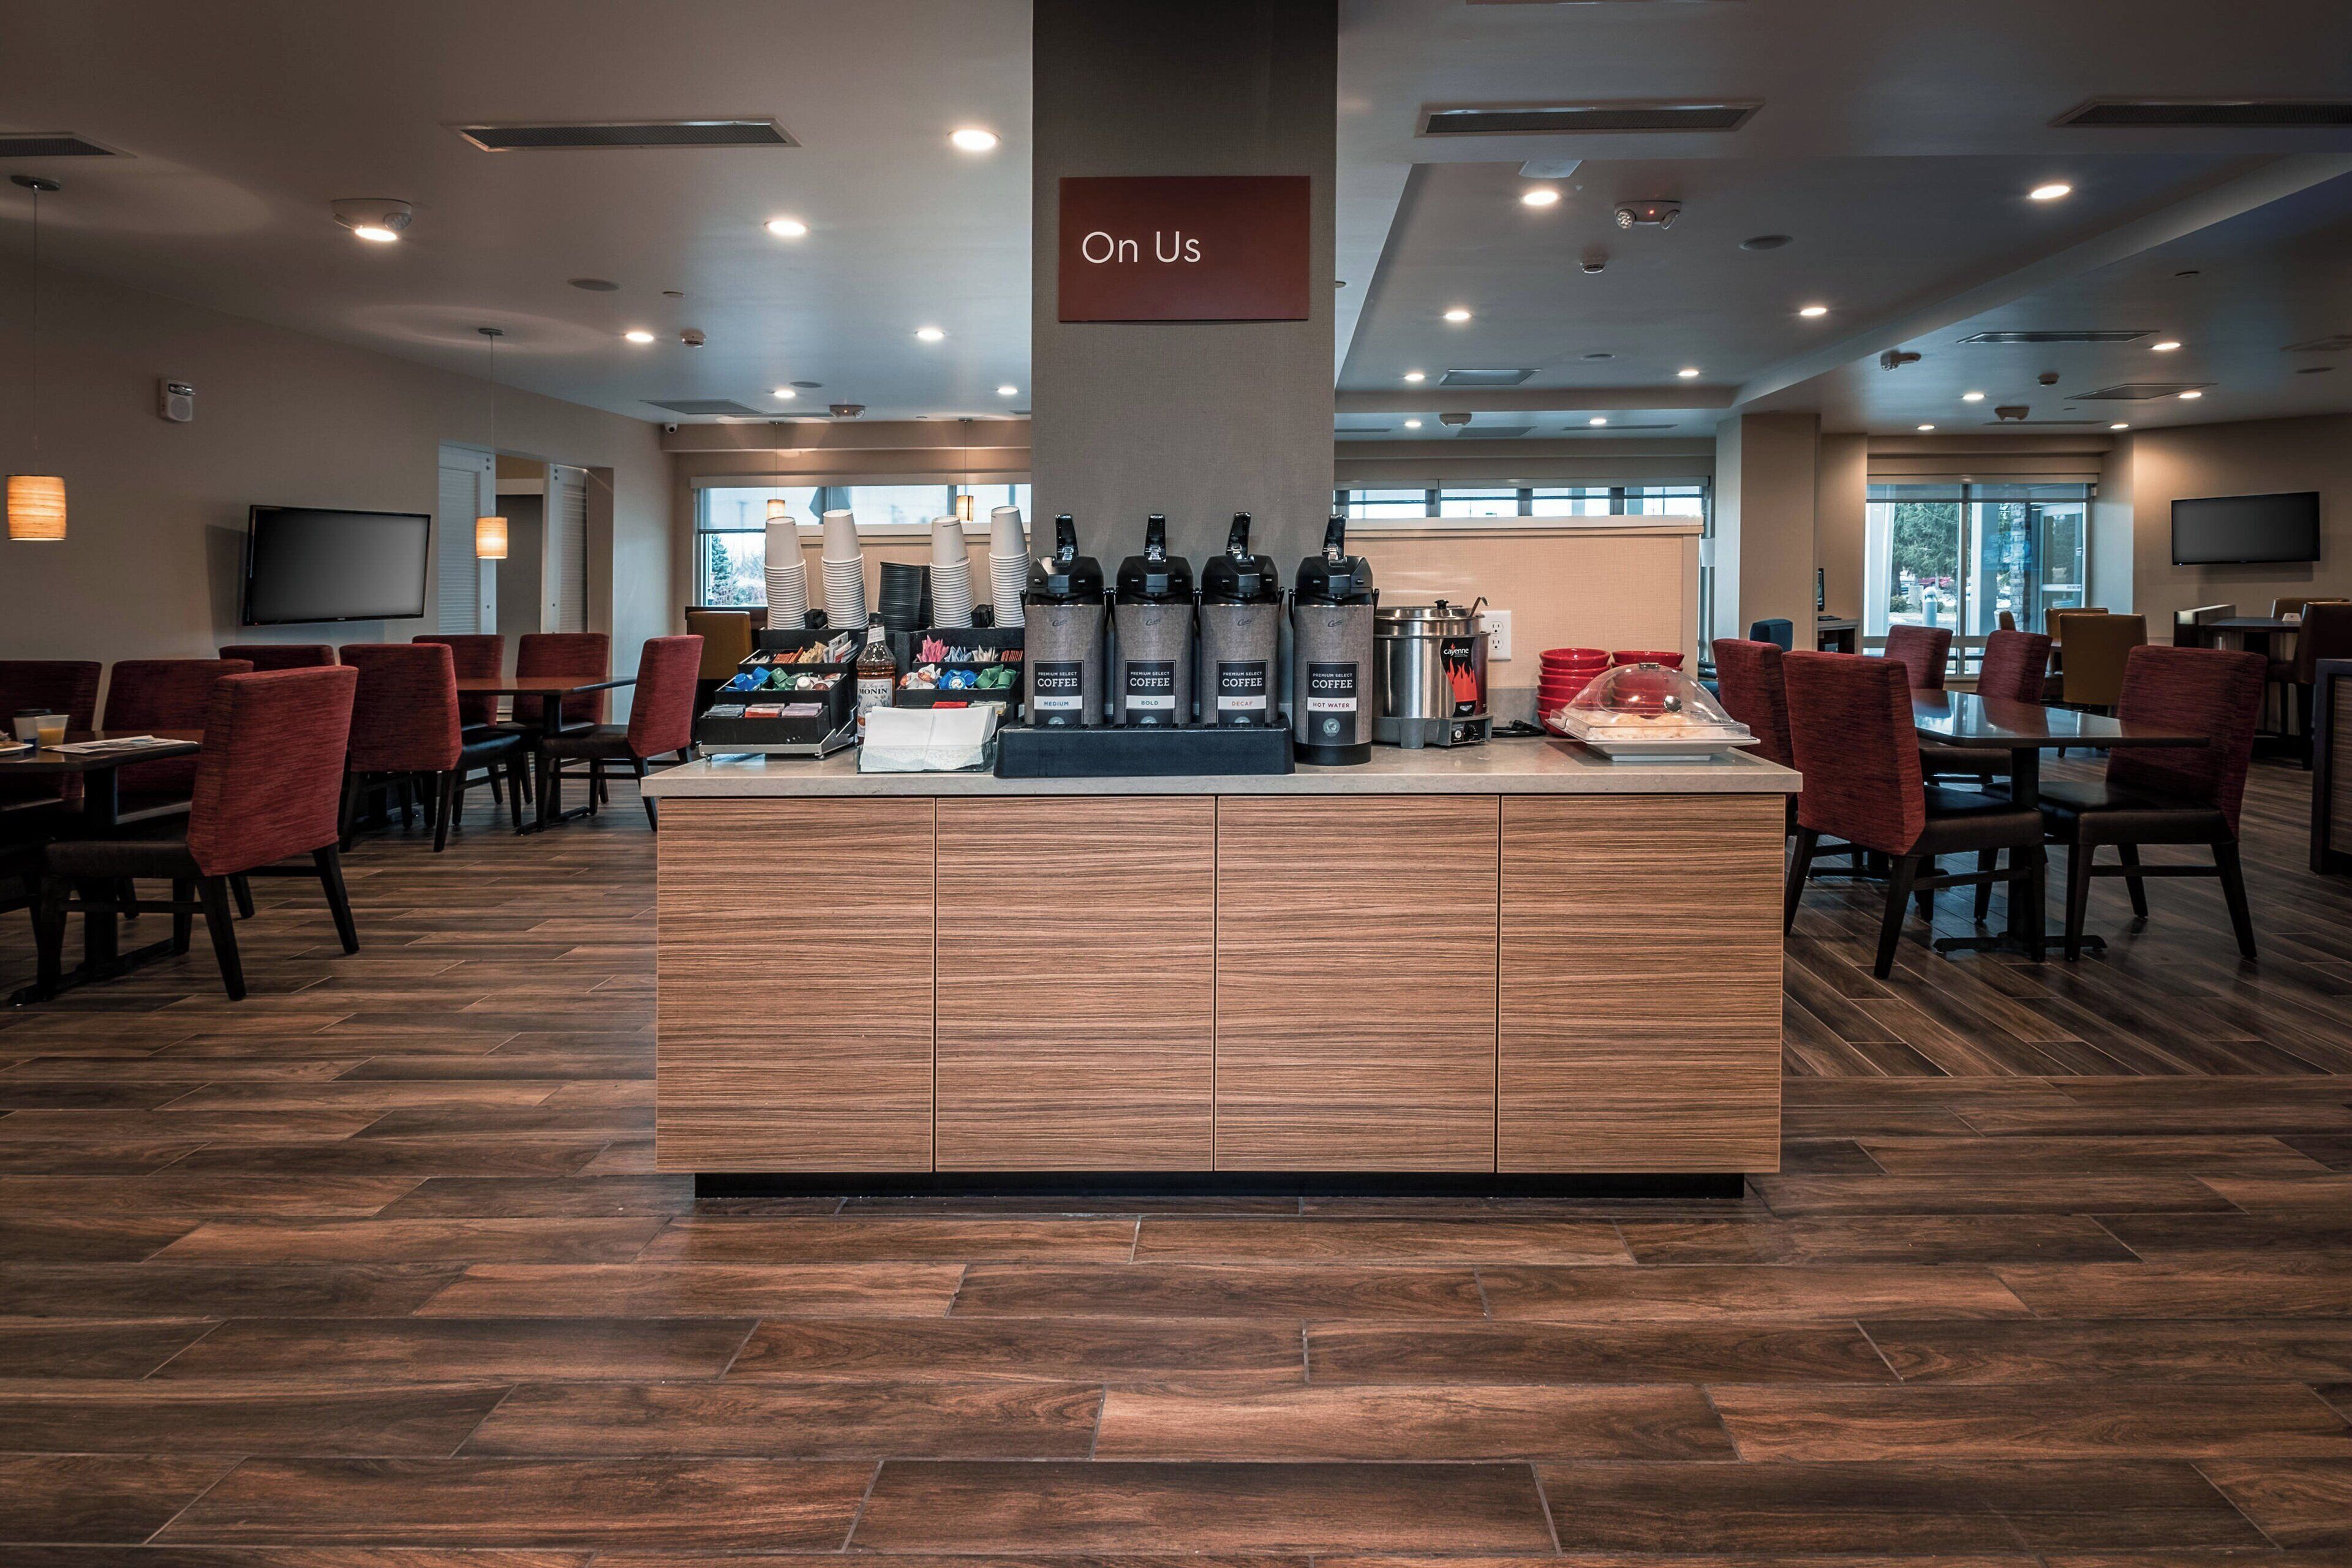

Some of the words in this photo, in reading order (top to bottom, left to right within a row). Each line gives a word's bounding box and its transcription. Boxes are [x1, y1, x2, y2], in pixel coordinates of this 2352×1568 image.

[1082, 232, 1138, 263] On
[1156, 231, 1200, 263] Us
[1038, 678, 1077, 687] COFFEE
[1130, 677, 1170, 687] COFFEE
[1222, 678, 1262, 687] COFFEE
[1312, 680, 1352, 688] COFFEE
